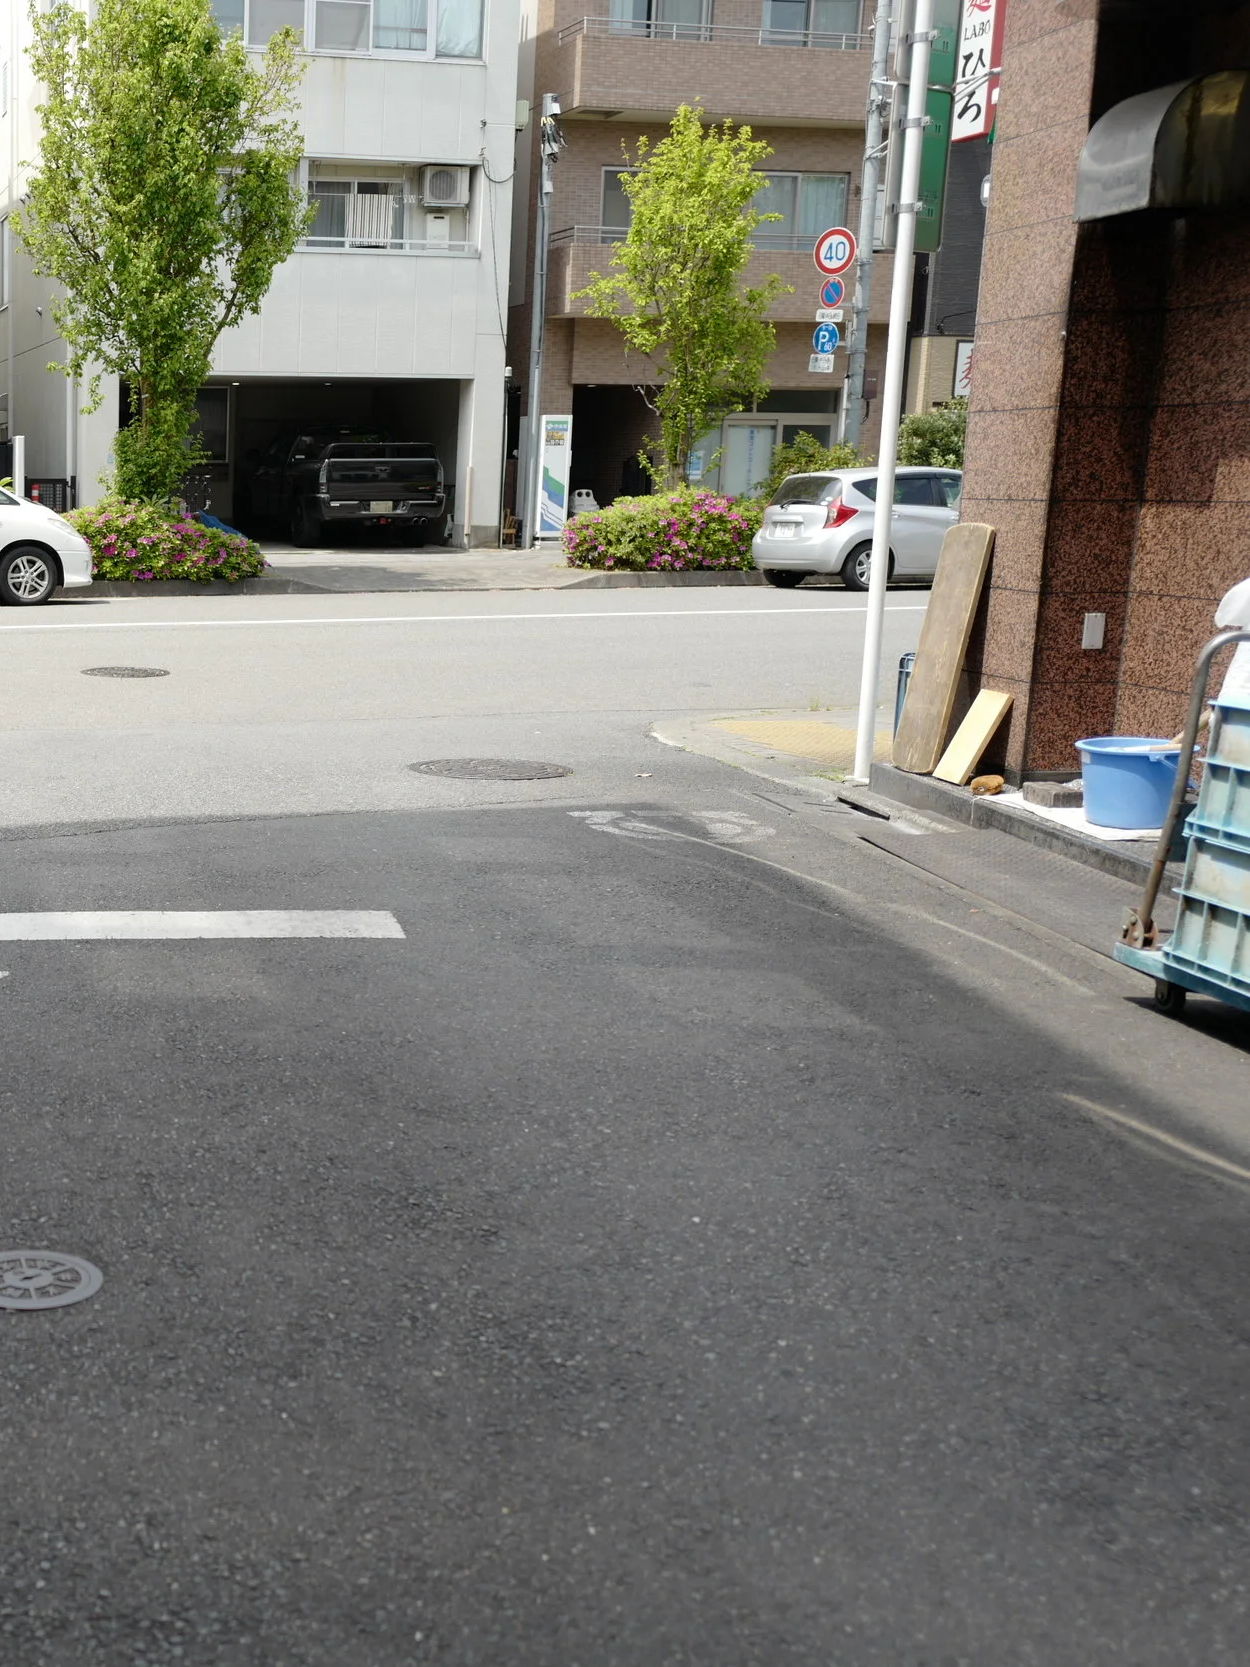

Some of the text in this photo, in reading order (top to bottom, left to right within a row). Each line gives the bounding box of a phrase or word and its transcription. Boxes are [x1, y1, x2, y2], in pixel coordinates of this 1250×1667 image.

[964, 20, 990, 41] LABO
[824, 241, 846, 262] 40
[818, 331, 829, 351] P
